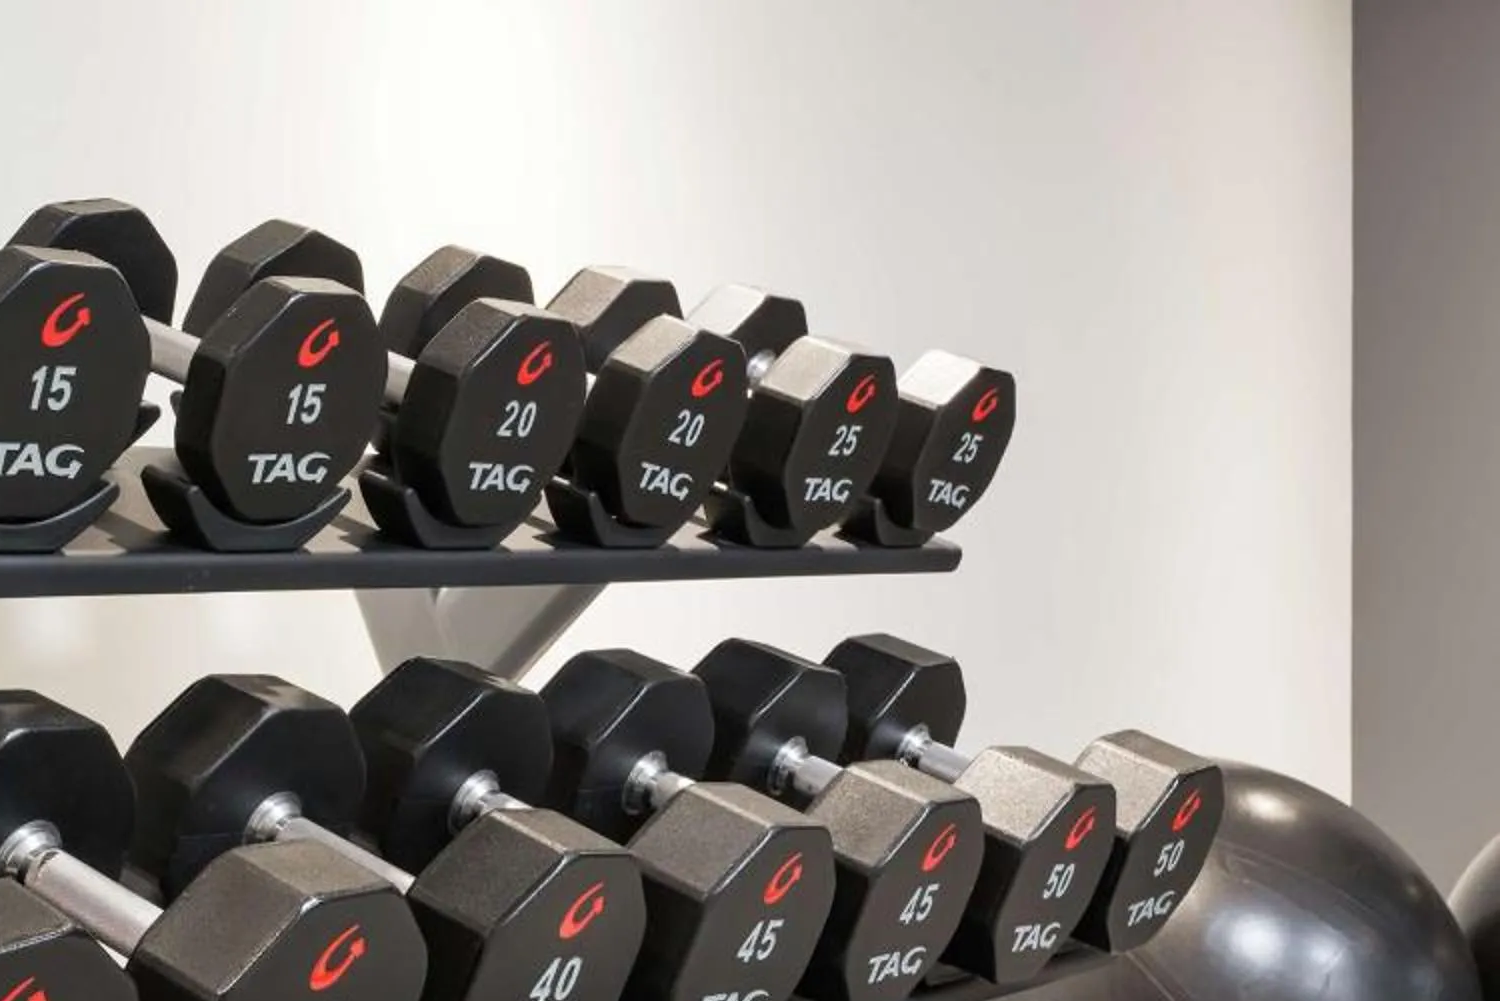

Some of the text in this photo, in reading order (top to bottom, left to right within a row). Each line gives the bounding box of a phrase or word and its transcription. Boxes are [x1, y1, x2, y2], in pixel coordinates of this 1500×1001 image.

[30, 365, 77, 411] 15
[286, 383, 327, 425] 15
[497, 399, 537, 438] 20
[667, 409, 705, 447] 20
[827, 424, 863, 456] 25
[952, 432, 984, 464] 25
[247, 451, 331, 484] TAG
[468, 461, 535, 494] TAG
[639, 462, 692, 501] TAG
[804, 477, 853, 504] TAG
[927, 479, 970, 510] TAG
[1153, 839, 1185, 877] 50
[1042, 863, 1075, 900] 50
[899, 883, 940, 925] 45
[1127, 890, 1174, 925] TAG
[736, 919, 785, 963] 45
[1011, 921, 1061, 953] TAG
[867, 946, 927, 984] TAG
